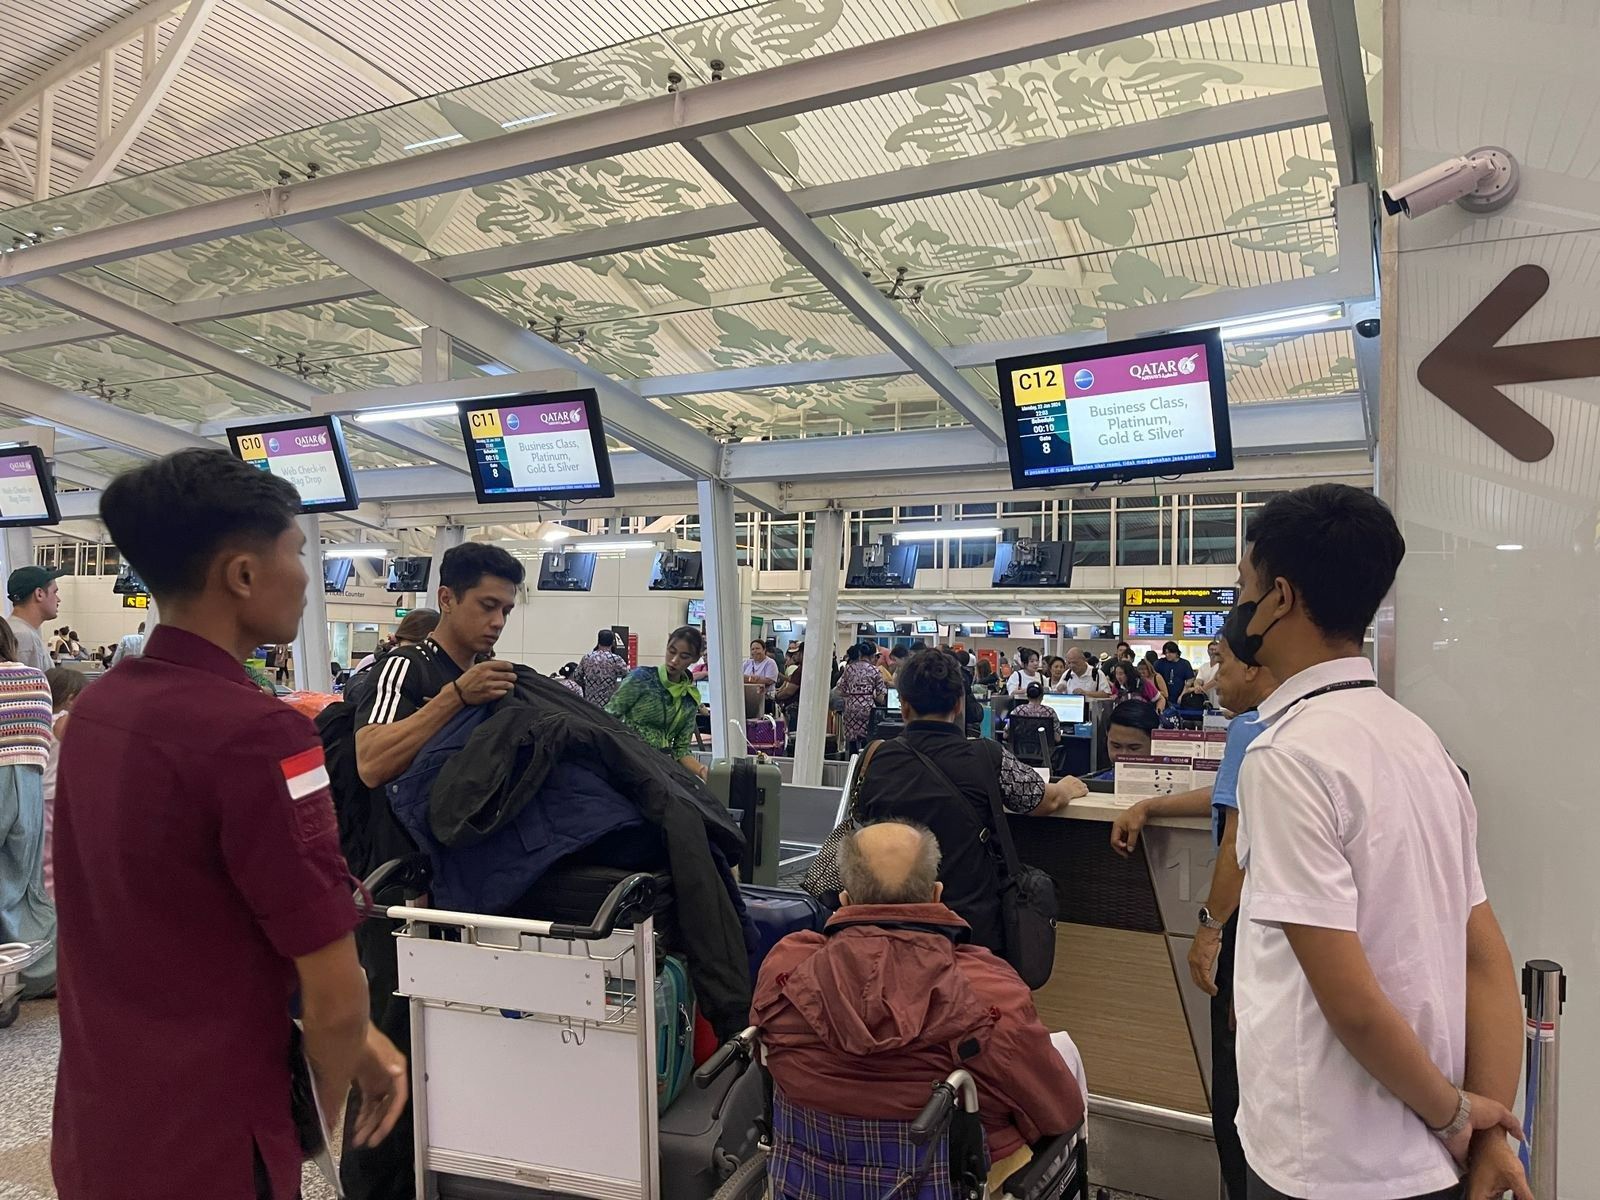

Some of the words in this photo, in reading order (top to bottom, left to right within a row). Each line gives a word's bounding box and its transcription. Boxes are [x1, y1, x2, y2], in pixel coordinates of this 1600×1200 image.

[1130, 360, 1177, 378] QATAR
[1019, 370, 1057, 390] C12
[1089, 403, 1146, 417] Business
[1150, 396, 1188, 410] Class,
[472, 413, 495, 427] C11
[540, 411, 569, 424] QATAR
[1107, 415, 1172, 430] Platinum,
[1033, 424, 1055, 433] 00:10
[295, 435, 318, 446] QATAR
[1098, 430, 1129, 446] Gold
[1133, 430, 1144, 442] &
[1148, 427, 1185, 441] Silver
[241, 437, 261, 450] C10
[519, 441, 554, 452] Business
[555, 438, 579, 449] Class,
[1042, 442, 1051, 454] 8
[531, 452, 571, 462] Platinum,
[281, 467, 297, 476] Web
[297, 464, 327, 474] Check-in
[492, 468, 499, 478] 8
[526, 464, 546, 474] Gold
[548, 464, 555, 472] &
[558, 462, 580, 472] Silver
[305, 476, 322, 485] Drop
